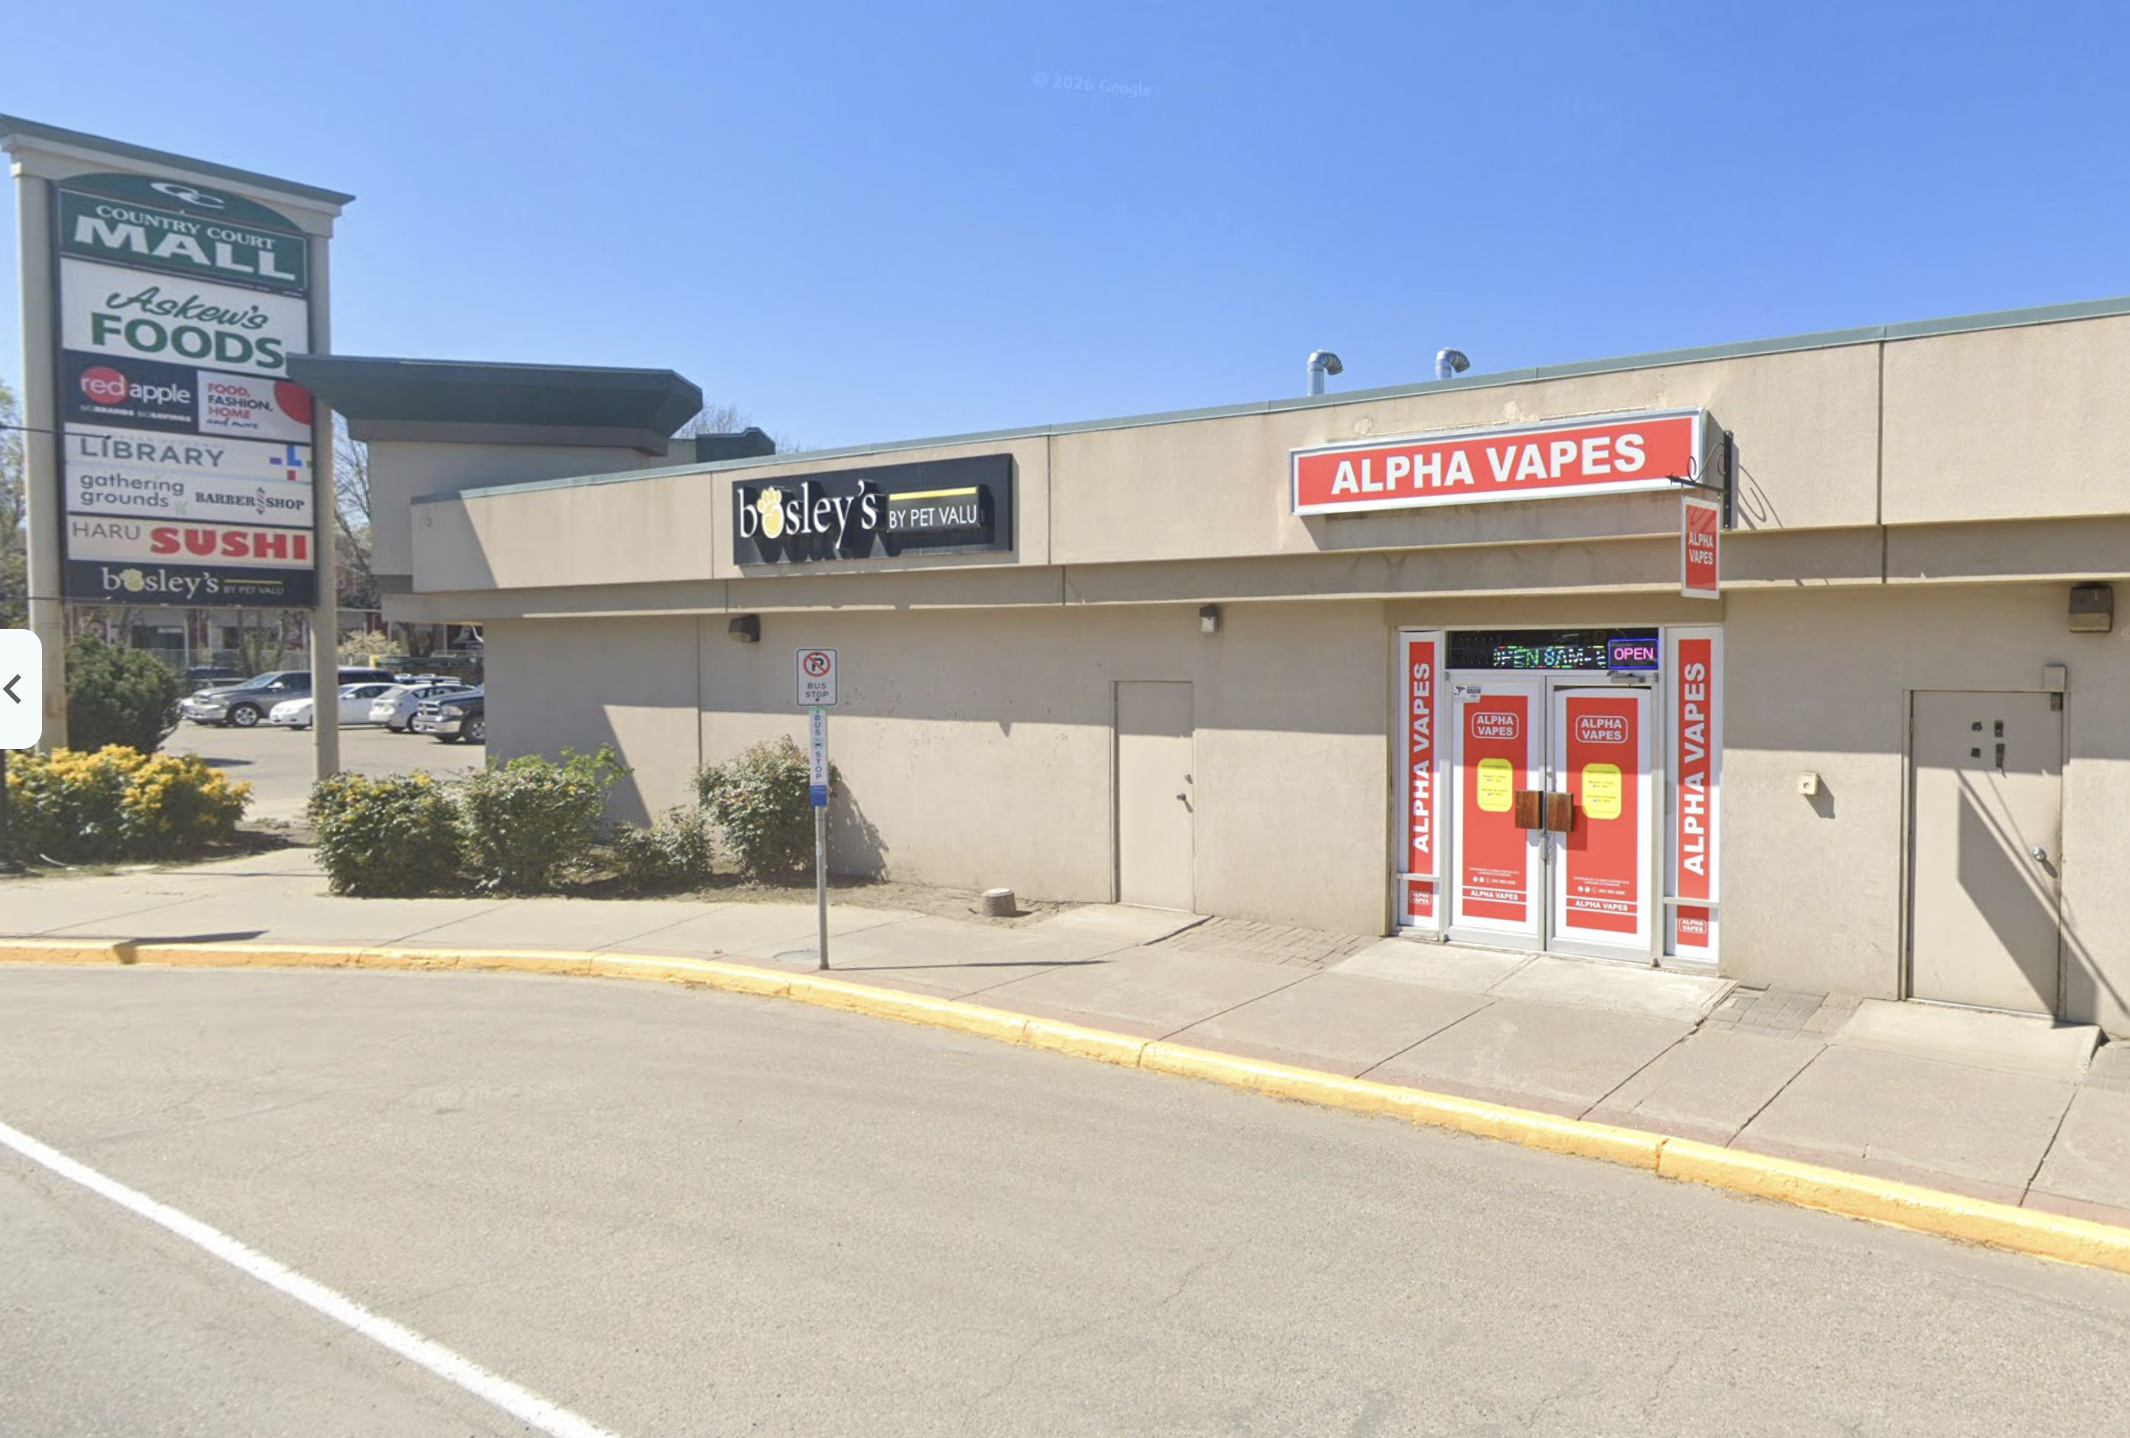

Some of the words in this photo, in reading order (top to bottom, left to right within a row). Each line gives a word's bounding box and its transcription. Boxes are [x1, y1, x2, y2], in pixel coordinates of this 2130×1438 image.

[96, 205, 201, 235] COUNTRY
[207, 227, 275, 250] COURT
[74, 215, 296, 281] MALL
[106, 286, 268, 330] Askew's
[91, 312, 284, 369] FOODS
[80, 374, 126, 397] red
[129, 381, 191, 405] apple
[208, 383, 250, 398] FOOD,
[208, 395, 273, 412] FASHION,
[208, 406, 251, 419] HOME
[206, 418, 229, 428] and
[80, 437, 224, 467] LIBRARY
[1331, 450, 1475, 495] ALPHA
[1486, 433, 1646, 482] VAPES
[80, 473, 184, 496] gathering
[80, 490, 169, 507] grounds
[195, 492, 255, 507] BARBER
[266, 497, 305, 510] SHOP
[738, 479, 878, 550] bosley's
[889, 510, 906, 528] BY
[911, 508, 935, 527] PET
[938, 505, 977, 525] VALU
[73, 522, 140, 540] HARU
[150, 527, 307, 560] SUSHI
[1688, 532, 1714, 548] ALPHA
[1689, 549, 1713, 565] VAPES
[101, 567, 219, 598] bosley's
[223, 586, 235, 594] BY
[239, 586, 256, 594] PET
[258, 587, 284, 595] VALU
[1614, 647, 1654, 661] OPEN
[1413, 663, 1430, 753] VAPES
[1684, 662, 1705, 764] VAPES
[1477, 714, 1514, 725] ALPHA
[1581, 718, 1622, 729] ALPHA
[1477, 726, 1513, 737] VAPES
[1581, 729, 1622, 740] VAPES
[1412, 759, 1429, 854] ALPHA
[1684, 771, 1705, 876] ALPHA
[1471, 890, 1494, 898] ALPHA
[1495, 892, 1518, 901] VAPES
[1575, 900, 1601, 909] ALPHA
[1602, 903, 1628, 912] VAPES
[1682, 918, 1704, 926] ALPHA
